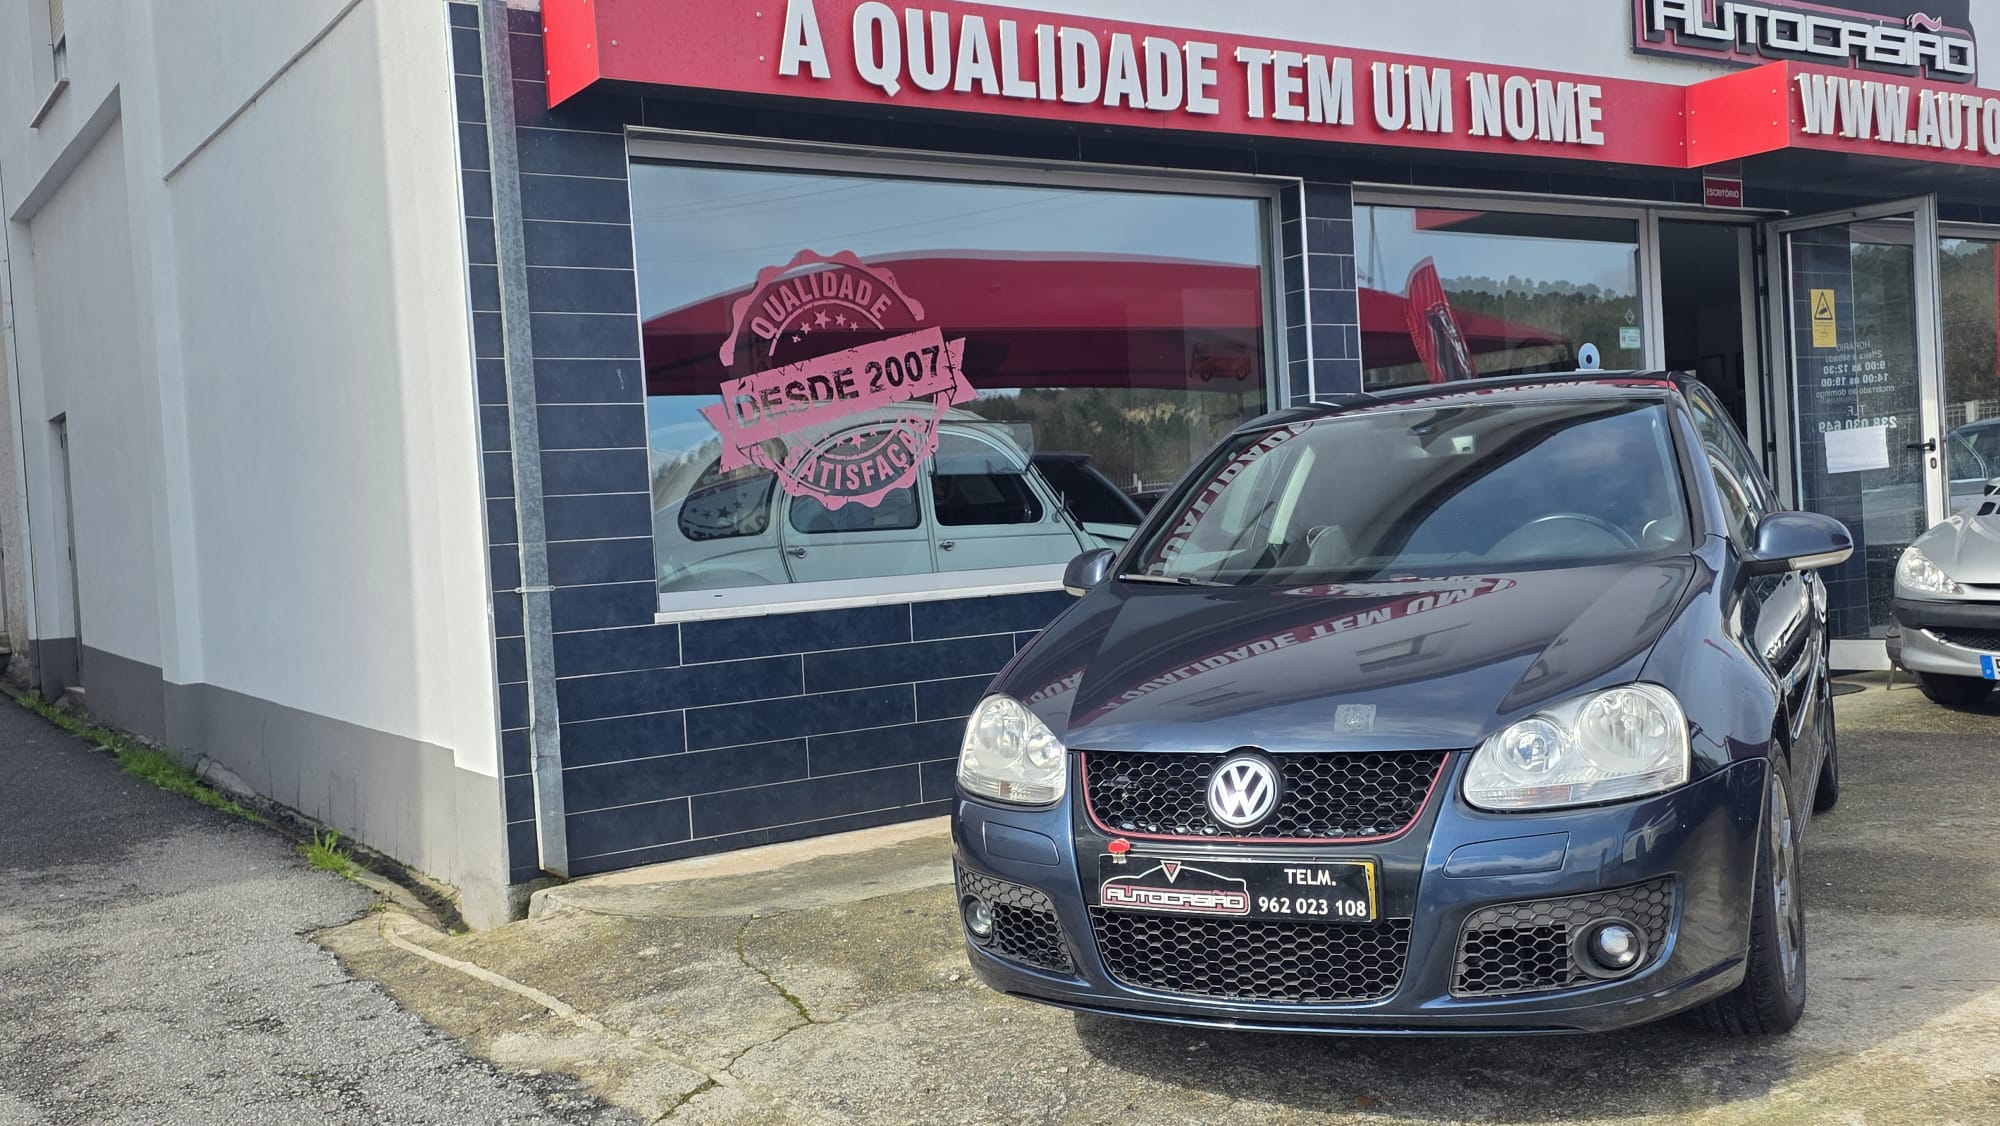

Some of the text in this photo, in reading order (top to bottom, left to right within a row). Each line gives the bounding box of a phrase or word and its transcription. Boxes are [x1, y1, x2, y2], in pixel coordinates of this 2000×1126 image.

[779, 0, 1605, 146] A QUALIDADE TEM UM NOME
[1706, 187, 1740, 199] ESCRITÓRIO
[751, 271, 892, 340] QUALIDADE
[733, 345, 940, 429] DESDE 2007
[1284, 868, 1337, 887] TELM.
[1258, 896, 1367, 917] 962 023 108
